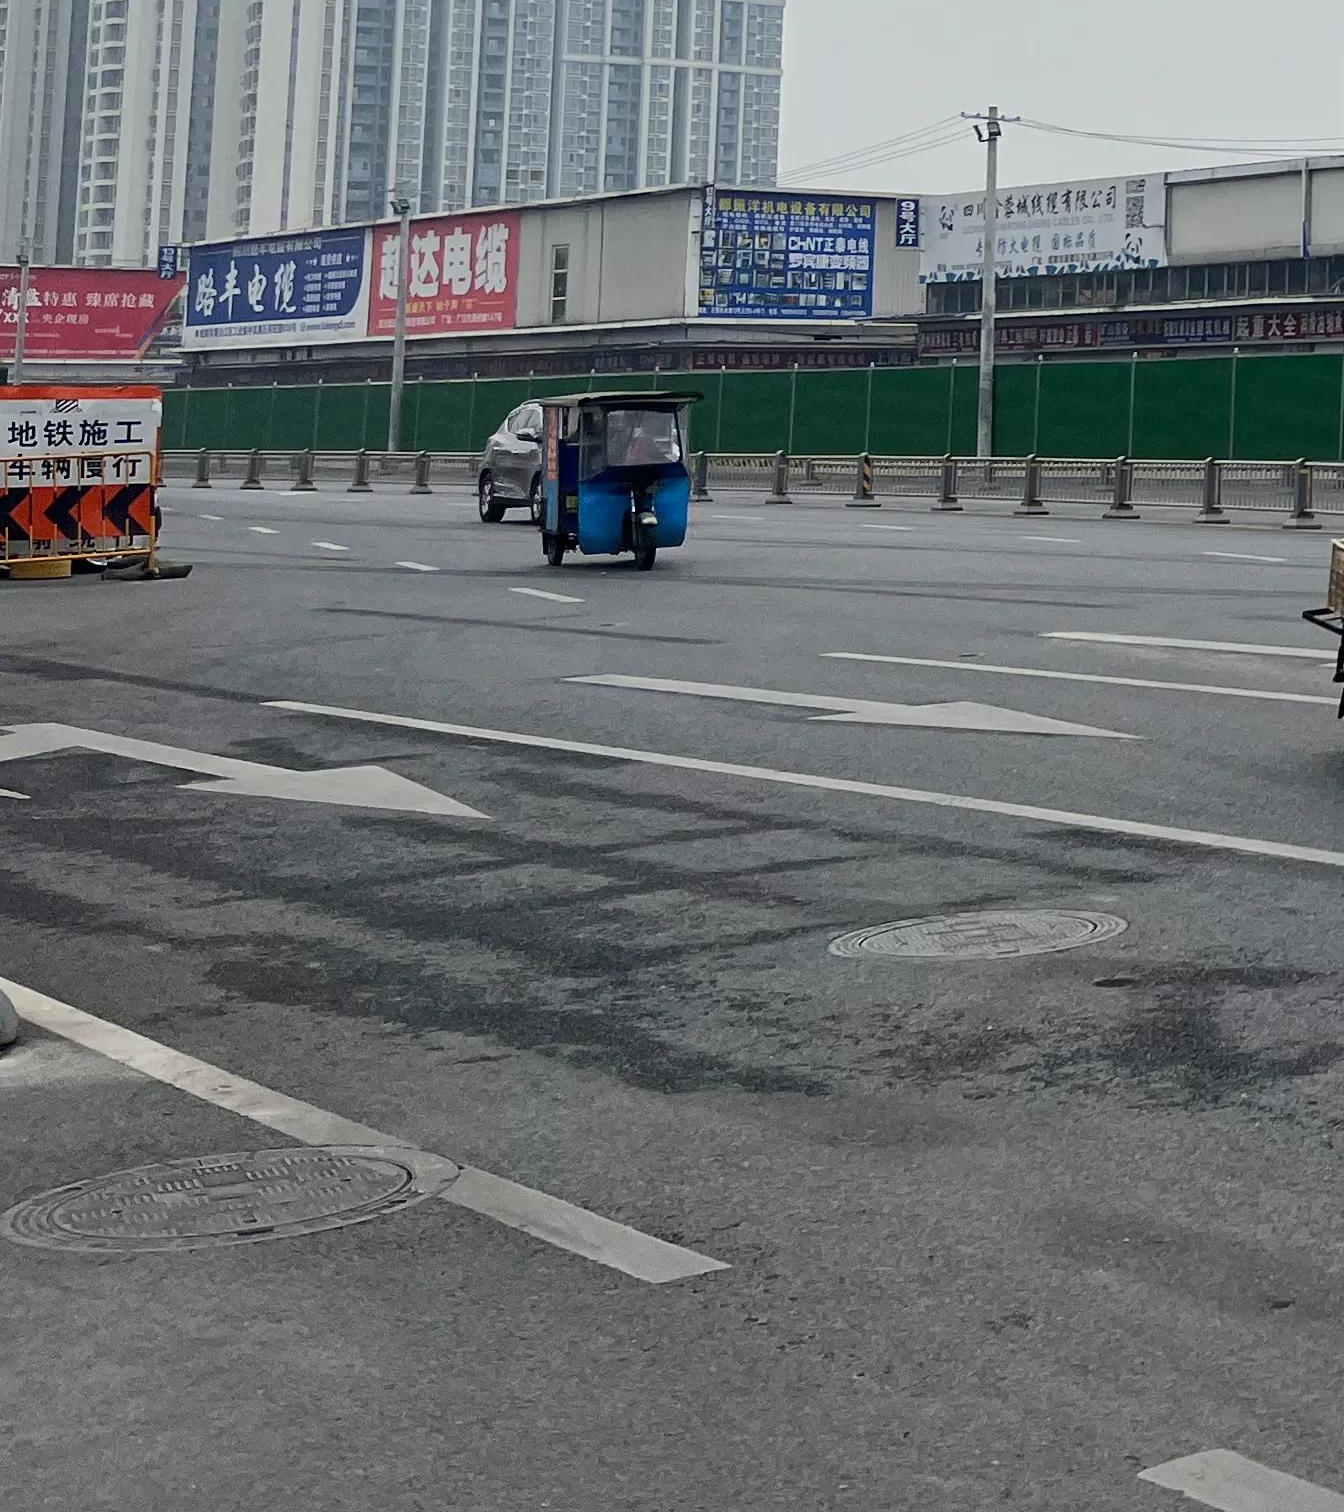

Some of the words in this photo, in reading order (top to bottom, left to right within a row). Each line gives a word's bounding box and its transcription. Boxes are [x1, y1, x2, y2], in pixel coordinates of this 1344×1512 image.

[898, 200, 917, 245] 9号大厅
[8, 419, 143, 447] 地铁施工
